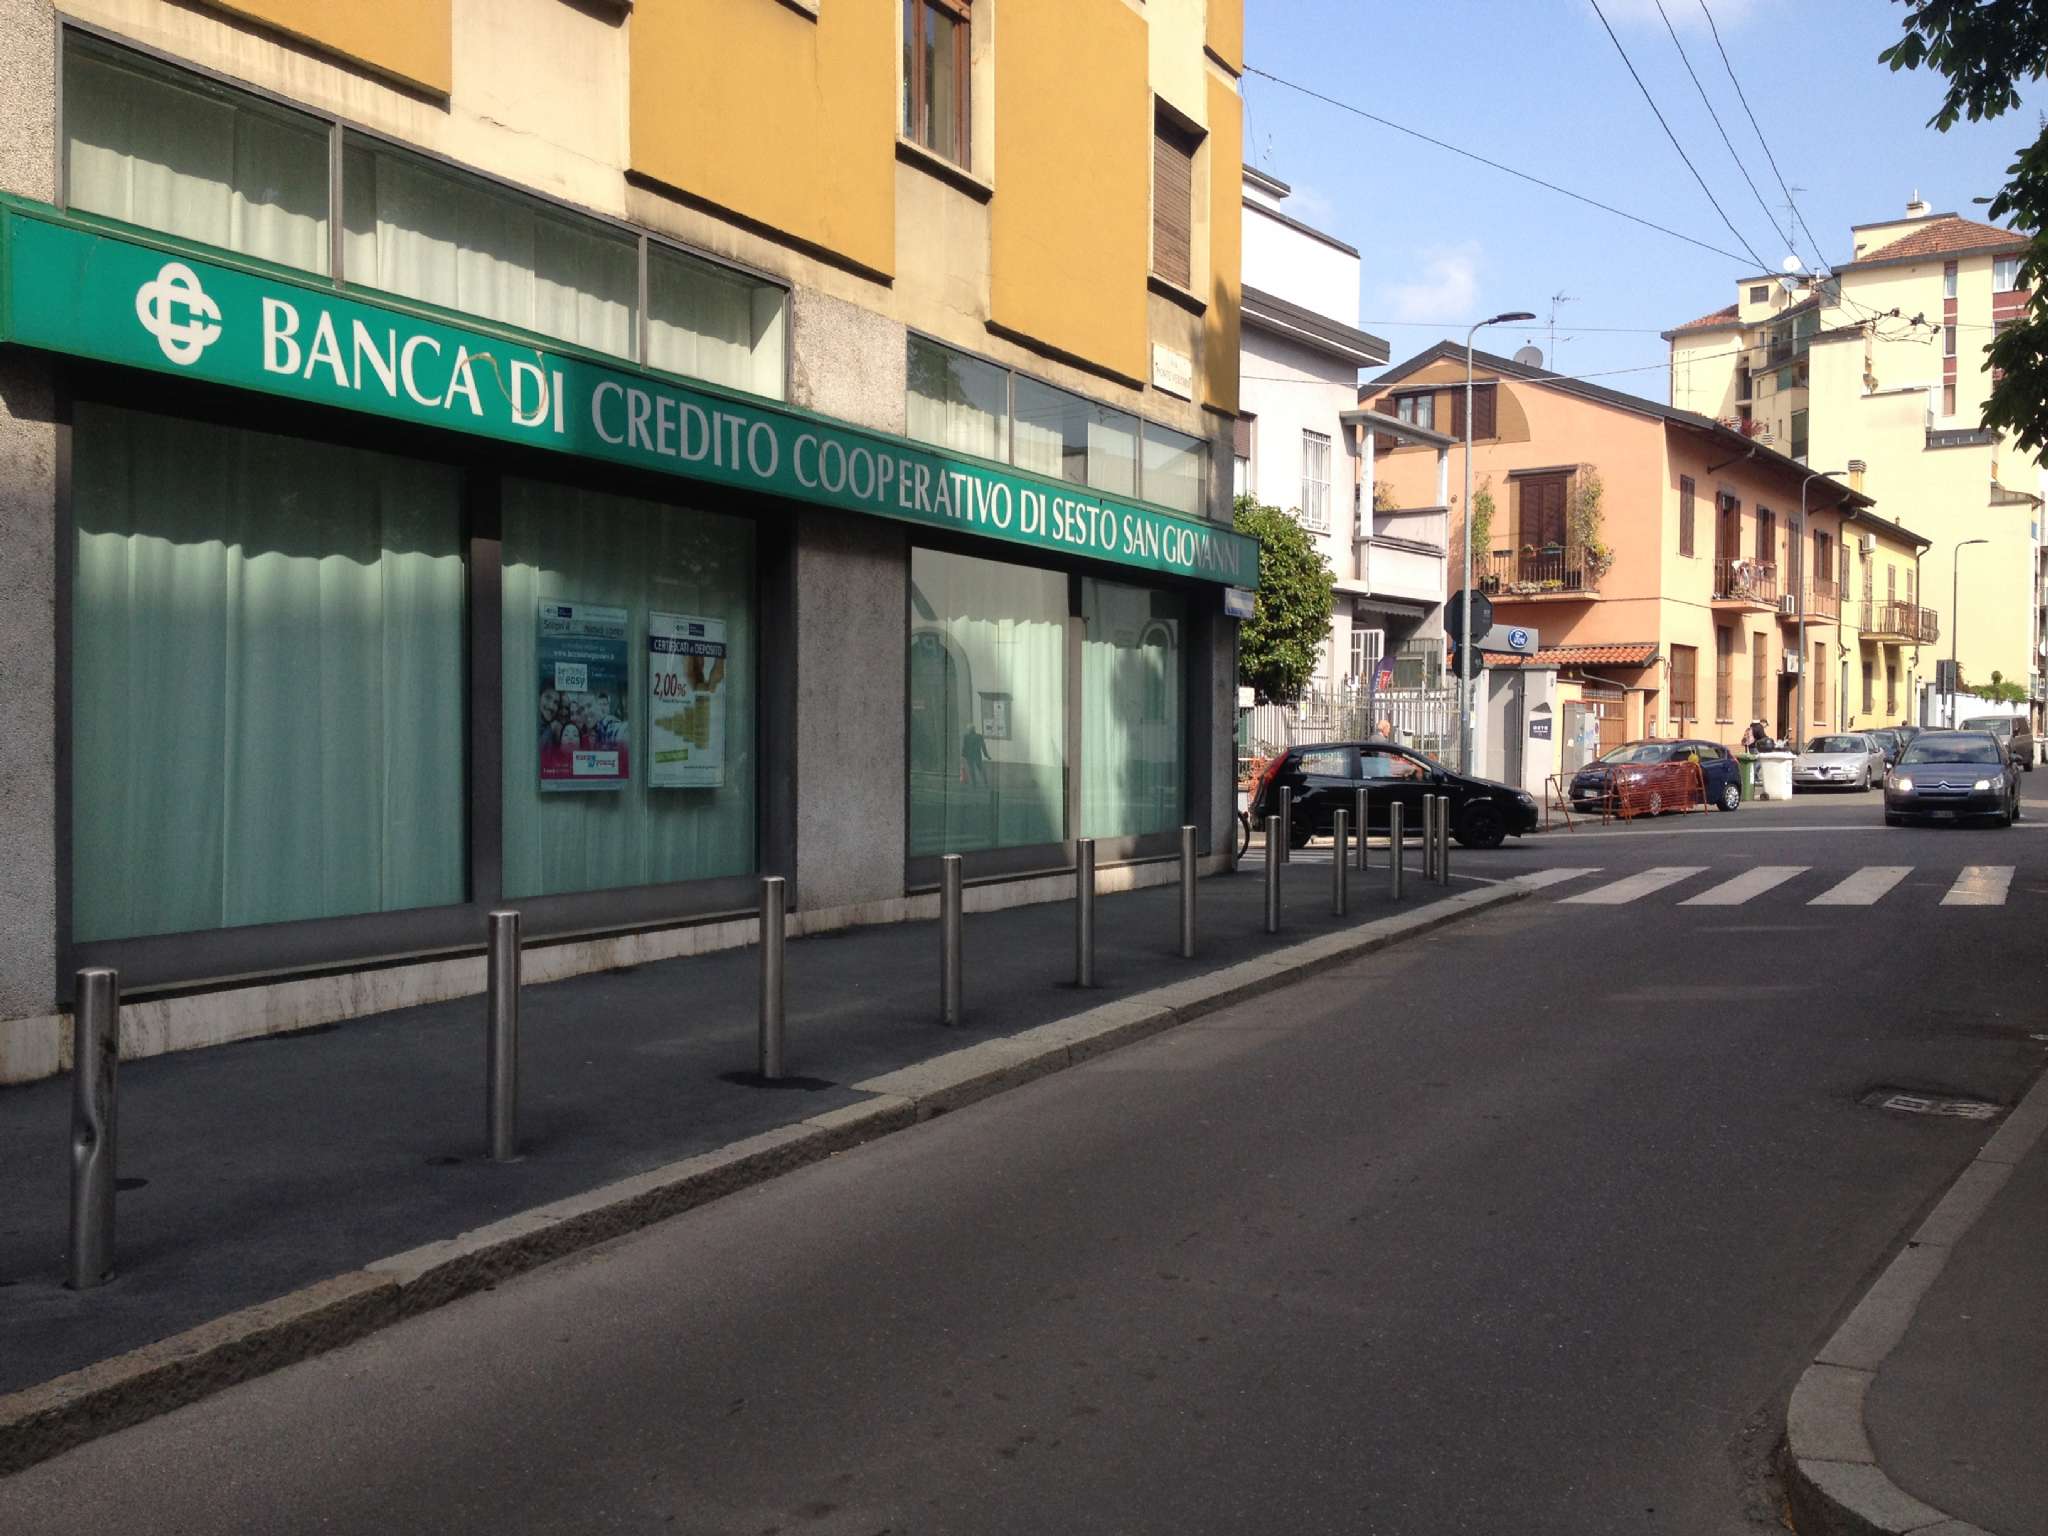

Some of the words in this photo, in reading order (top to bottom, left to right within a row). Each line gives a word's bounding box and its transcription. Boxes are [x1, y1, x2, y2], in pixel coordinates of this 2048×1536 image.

[262, 297, 484, 416] BANCA
[511, 358, 565, 434] DI
[591, 381, 779, 479] CREDITO
[793, 434, 1012, 529] COOPERATIVO
[1020, 487, 1047, 534] DI
[1052, 497, 1118, 551] SESTO
[1123, 514, 1160, 560] SAN
[1163, 525, 1240, 577] GIOVANNI
[654, 639, 689, 653] CERTIFICATI
[694, 644, 723, 657] DEPOSITO
[653, 672, 687, 699] 2,00%
